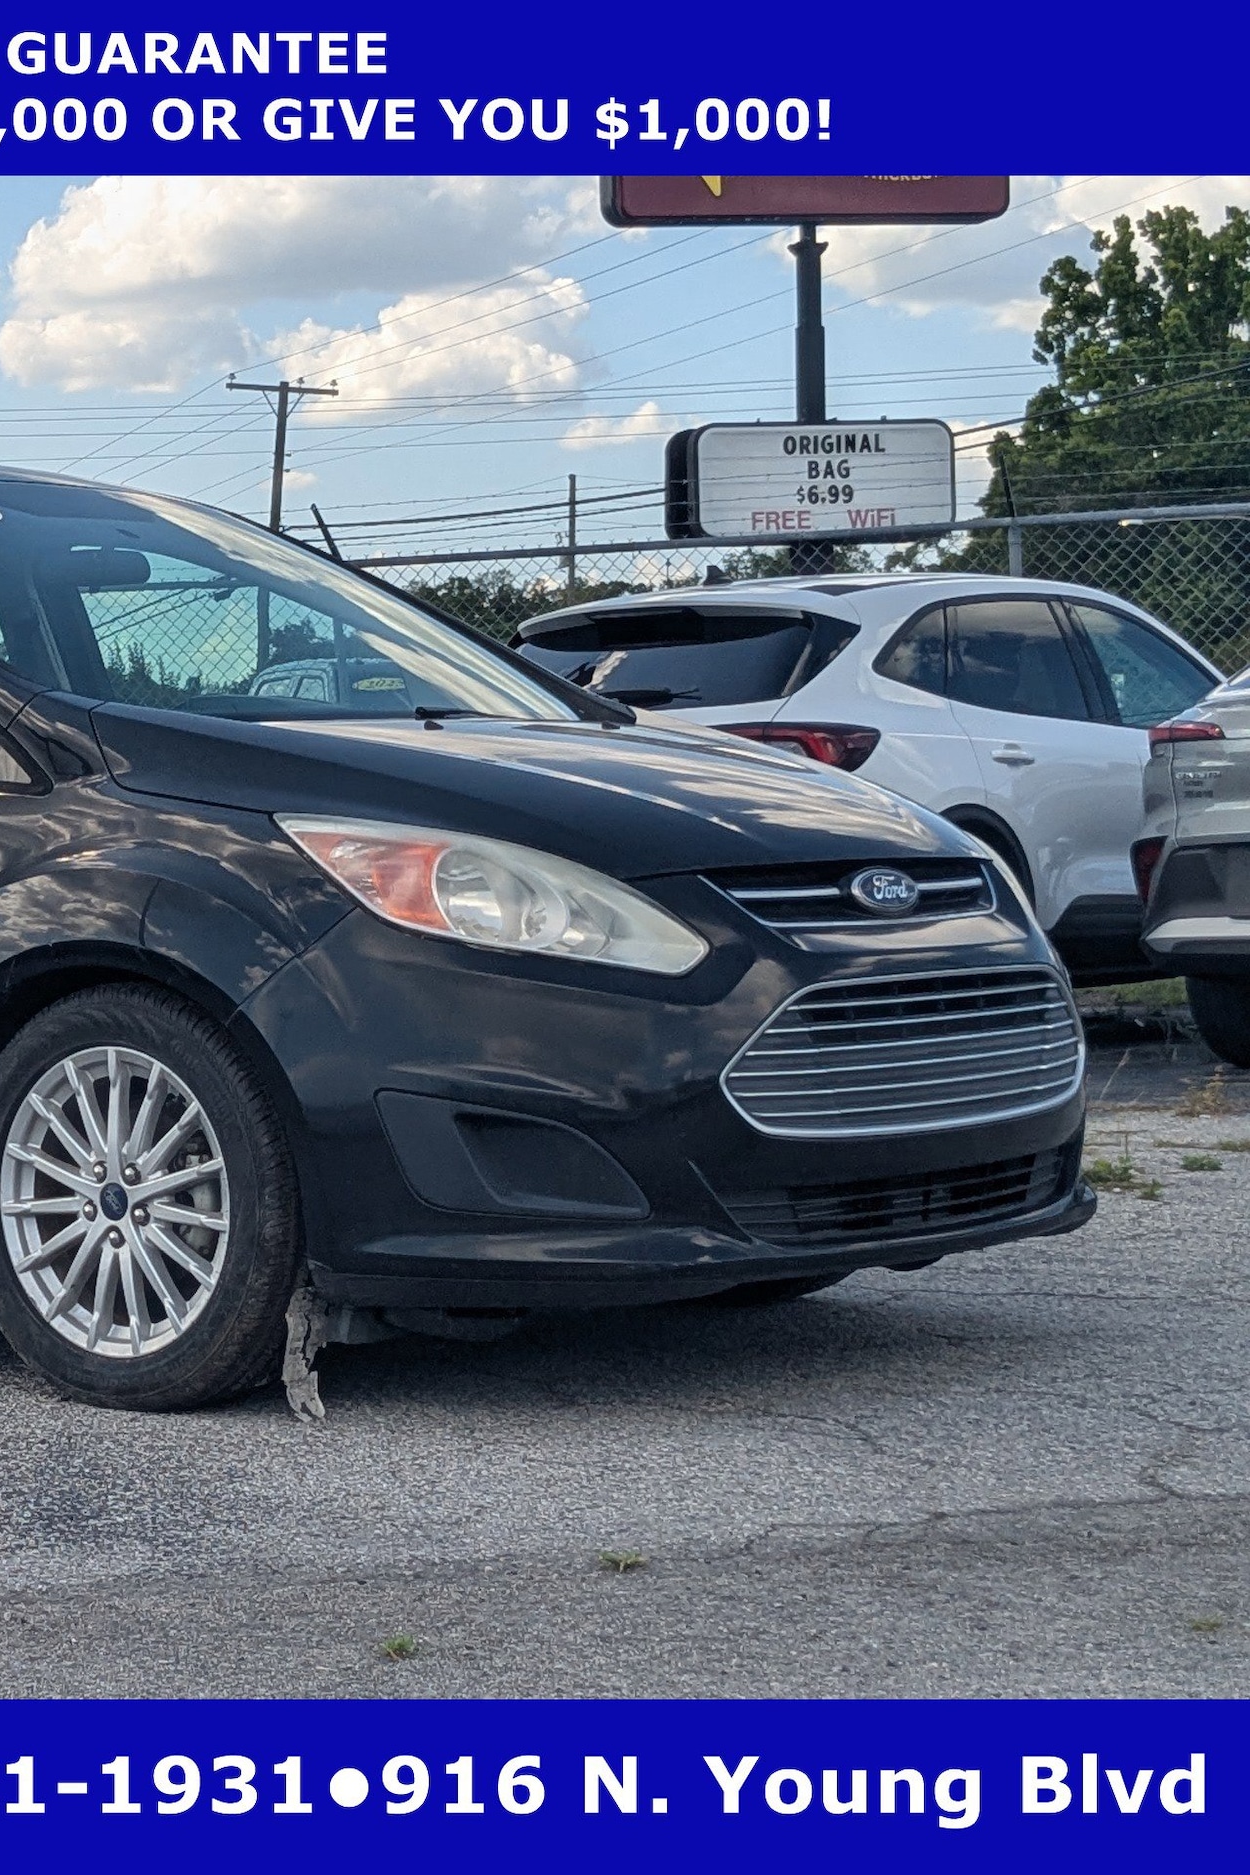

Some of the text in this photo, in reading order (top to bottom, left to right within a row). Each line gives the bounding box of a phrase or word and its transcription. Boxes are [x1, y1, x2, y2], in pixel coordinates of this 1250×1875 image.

[783, 433, 886, 455] ORIGINAL
[807, 459, 851, 479] BAG
[796, 484, 854, 505] $6.99
[751, 508, 896, 531] FREE WiFi
[872, 875, 908, 900] Ford
